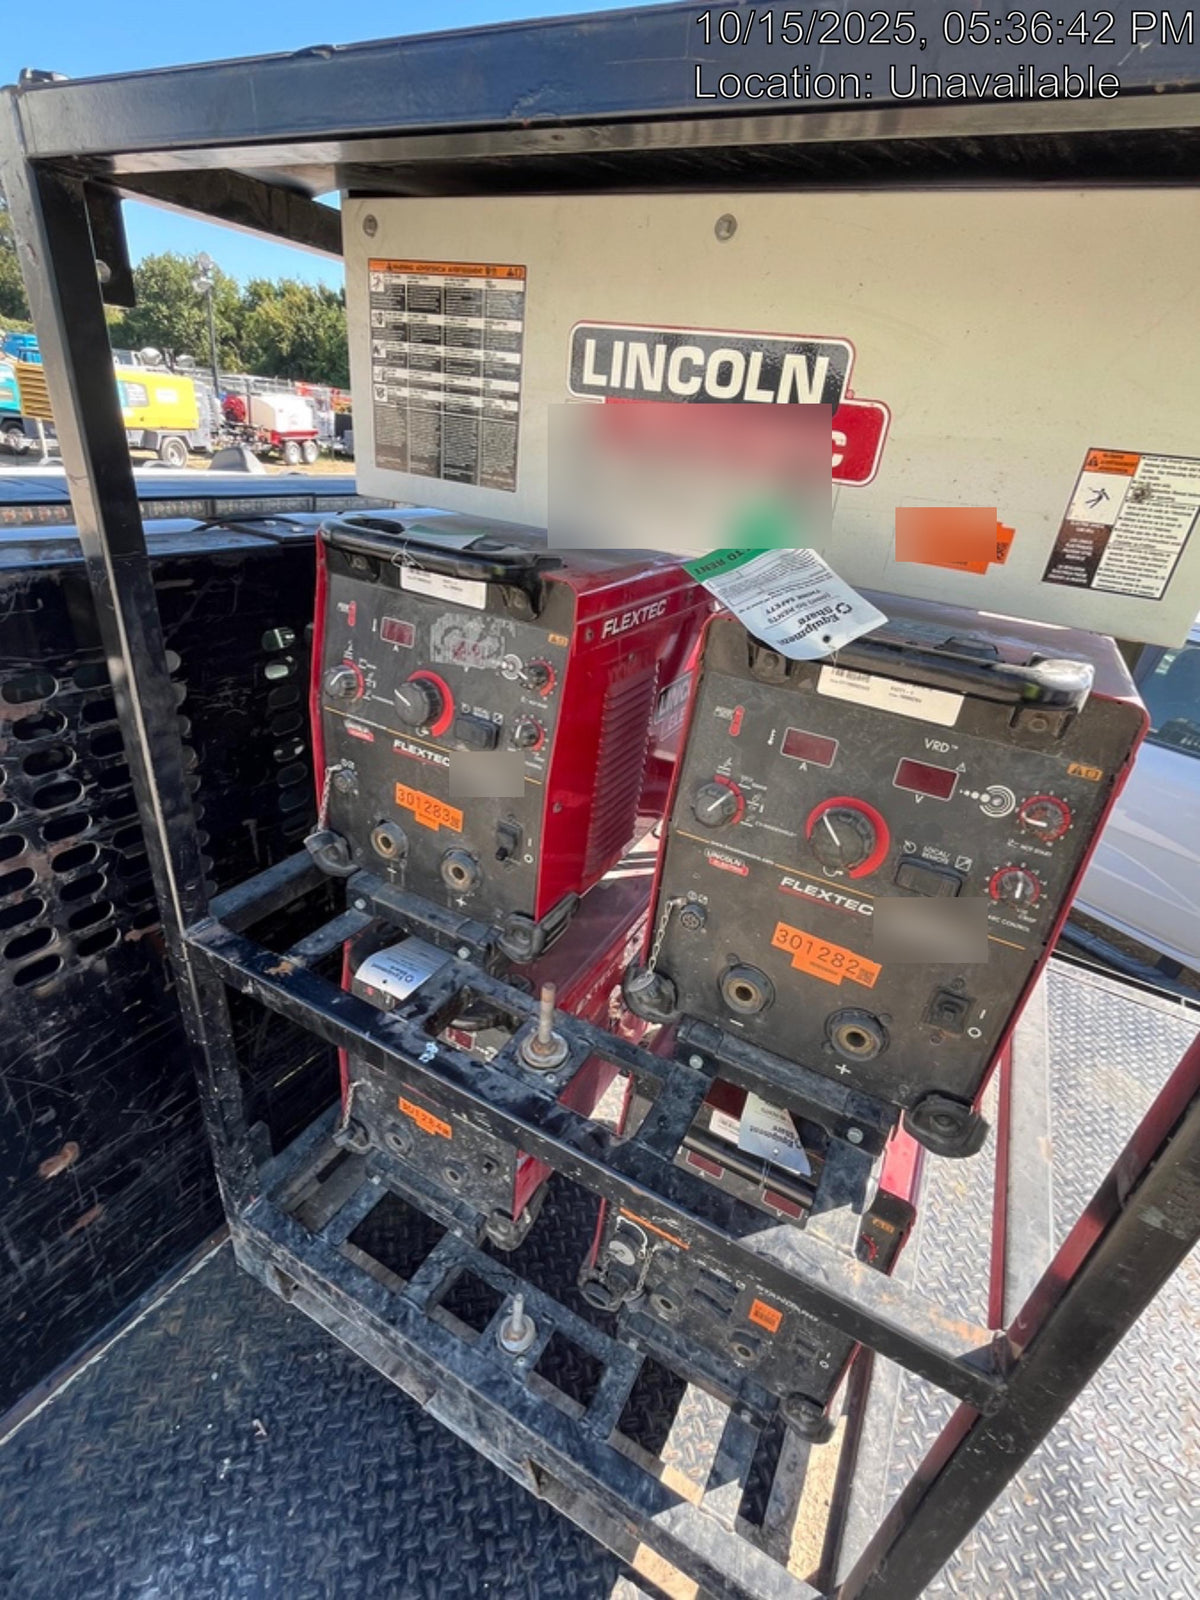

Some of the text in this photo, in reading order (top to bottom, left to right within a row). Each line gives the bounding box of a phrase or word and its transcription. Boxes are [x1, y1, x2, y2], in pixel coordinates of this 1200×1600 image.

[583, 338, 830, 404] LINCOLN
[601, 599, 668, 640] FLEXTEC
[776, 613, 840, 647] Equipment
[797, 605, 833, 626] Share
[393, 738, 450, 767] FLEXTEC
[397, 787, 451, 823] 301283
[780, 875, 875, 917] FLEXTEC
[775, 927, 862, 976] 301282
